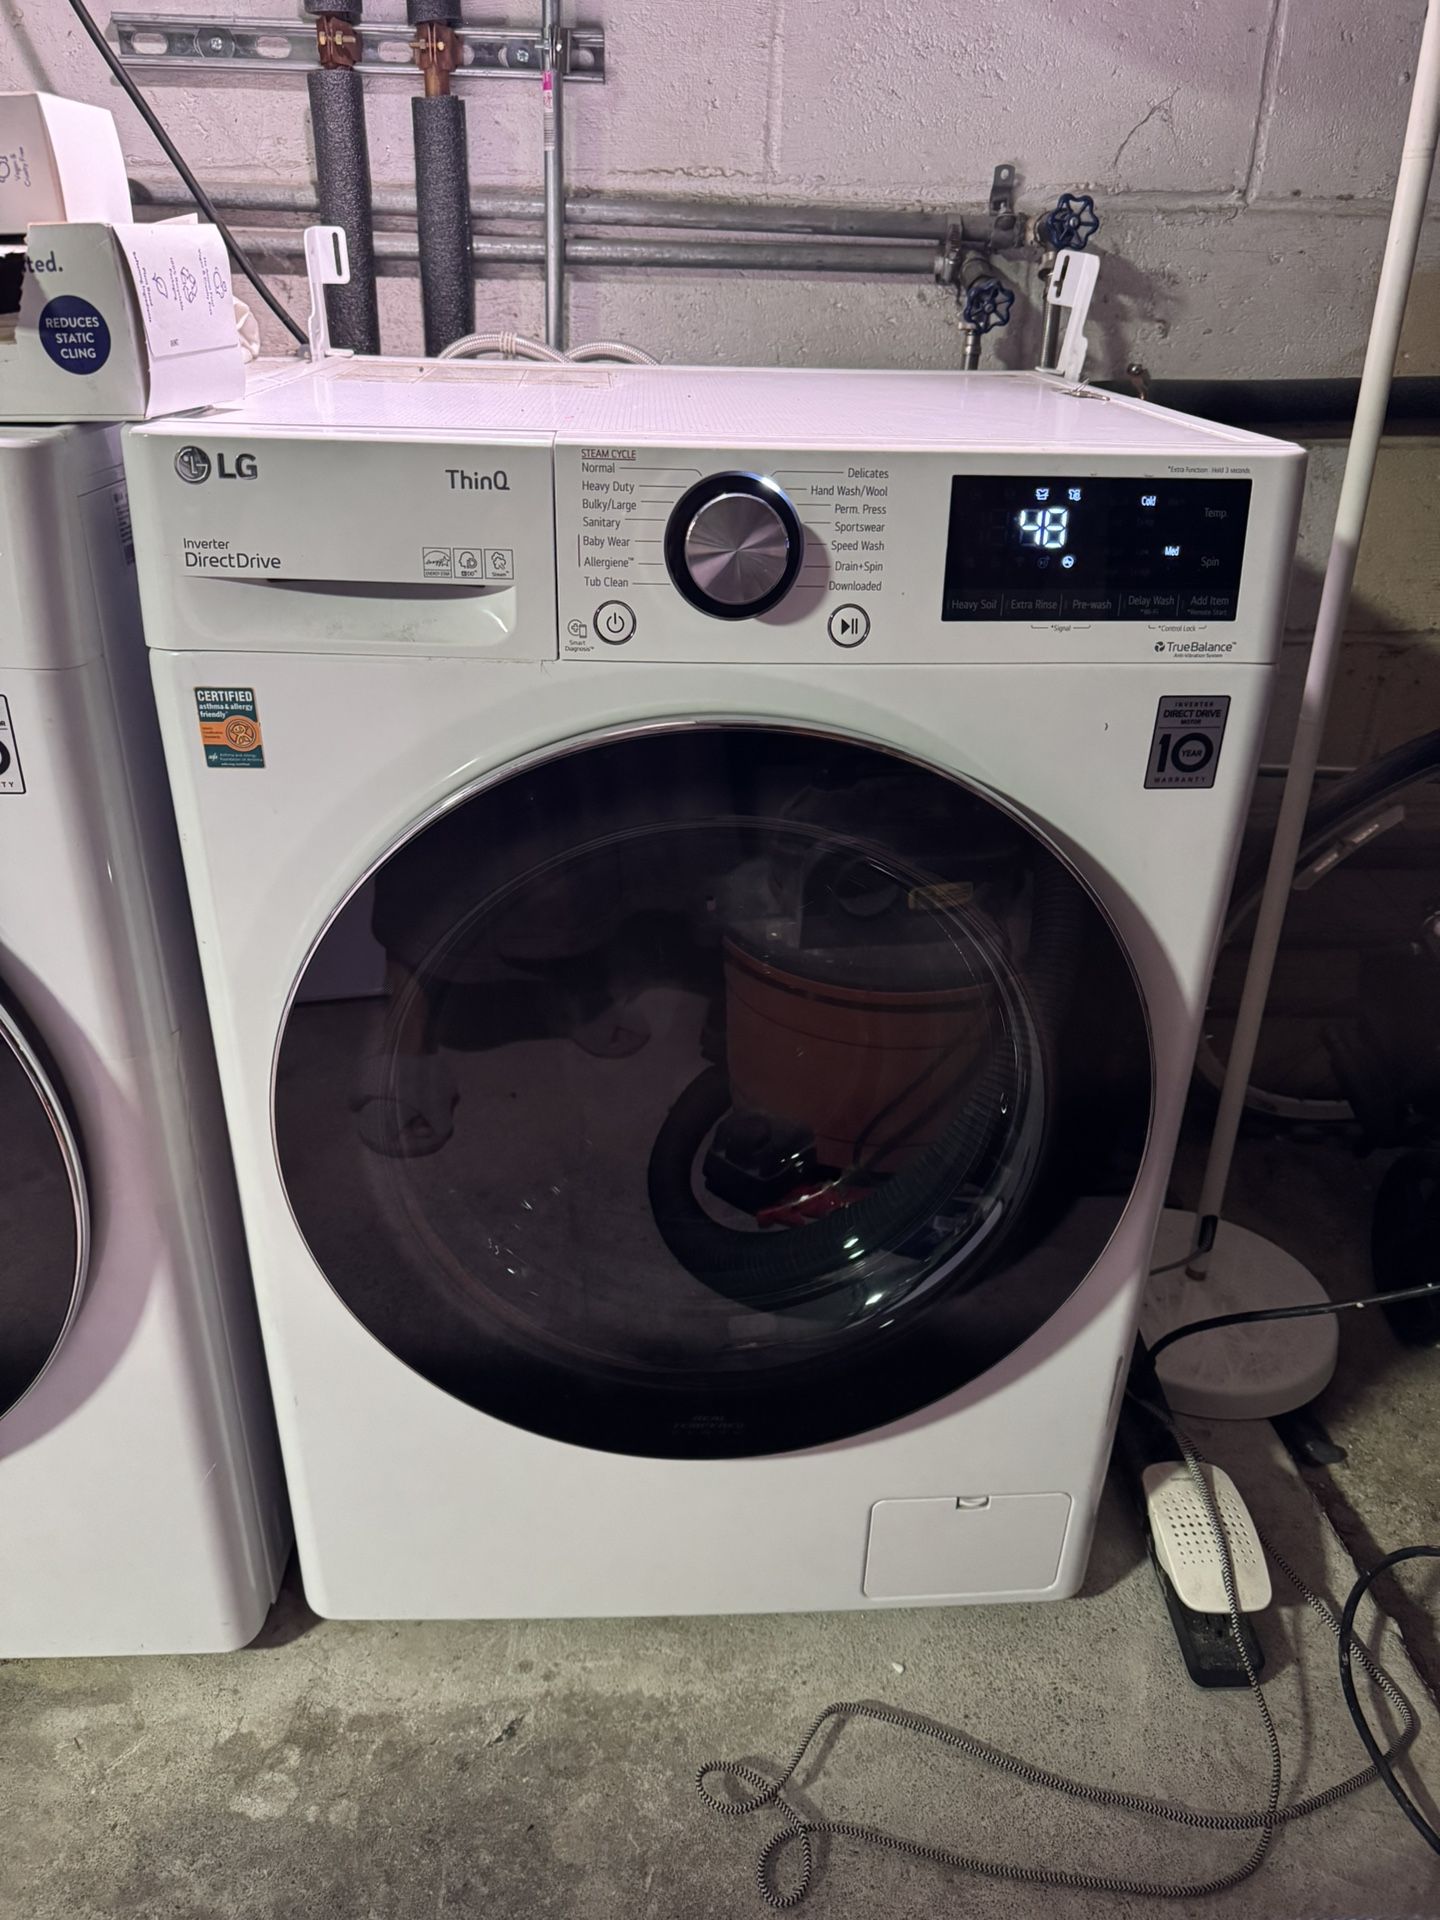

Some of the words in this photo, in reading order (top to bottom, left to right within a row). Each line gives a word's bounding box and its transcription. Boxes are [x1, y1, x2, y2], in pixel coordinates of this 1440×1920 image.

[45, 317, 99, 329] REDUCES
[55, 332, 95, 344] STATIC
[60, 348, 97, 359] CLING
[581, 449, 609, 458] STEAM
[611, 449, 636, 459] CYCLE
[217, 453, 258, 480] LG
[581, 462, 615, 473] Normal
[847, 467, 889, 479] Delicates
[445, 469, 511, 490] ThinQ
[581, 480, 610, 494] Heavy
[612, 481, 635, 495] Duty
[811, 485, 835, 496] Hand
[837, 485, 888, 497] Wash/Wool
[582, 498, 637, 512] Bulky/Large
[1141, 495, 1157, 507] Cold
[834, 503, 860, 514] Perm.
[862, 503, 887, 515] Press
[582, 516, 621, 530] Sanitary
[834, 521, 885, 534] Sportswear
[1019, 507, 1068, 549] 48
[183, 538, 230, 550] Inverter
[583, 536, 605, 549] Baby
[607, 537, 631, 547] Wear
[831, 540, 859, 552] Speed
[861, 540, 885, 551] Wash
[1164, 546, 1180, 556] Med
[834, 560, 883, 573] Drain+Spin
[1200, 556, 1220, 568] Spin
[584, 576, 601, 587] Tub
[603, 577, 629, 588] Clean
[828, 581, 882, 592] Downloaded
[951, 599, 978, 612] Heavy
[980, 599, 998, 610] Soil
[1011, 599, 1033, 610] Extra
[1035, 599, 1058, 609] Rinse
[1072, 599, 1112, 609] Pre-wash
[1128, 595, 1152, 608] Delay
[1153, 595, 1175, 606] Wash
[1190, 596, 1208, 606] Add
[1209, 596, 1230, 606] Item
[197, 690, 253, 702] CERTIFIED
[230, 703, 253, 711] allergy
[1163, 709, 1194, 718] DIRECT
[1195, 709, 1222, 718] DRIVE
[1157, 732, 1214, 773] 10
[1182, 749, 1203, 757] YEAR
